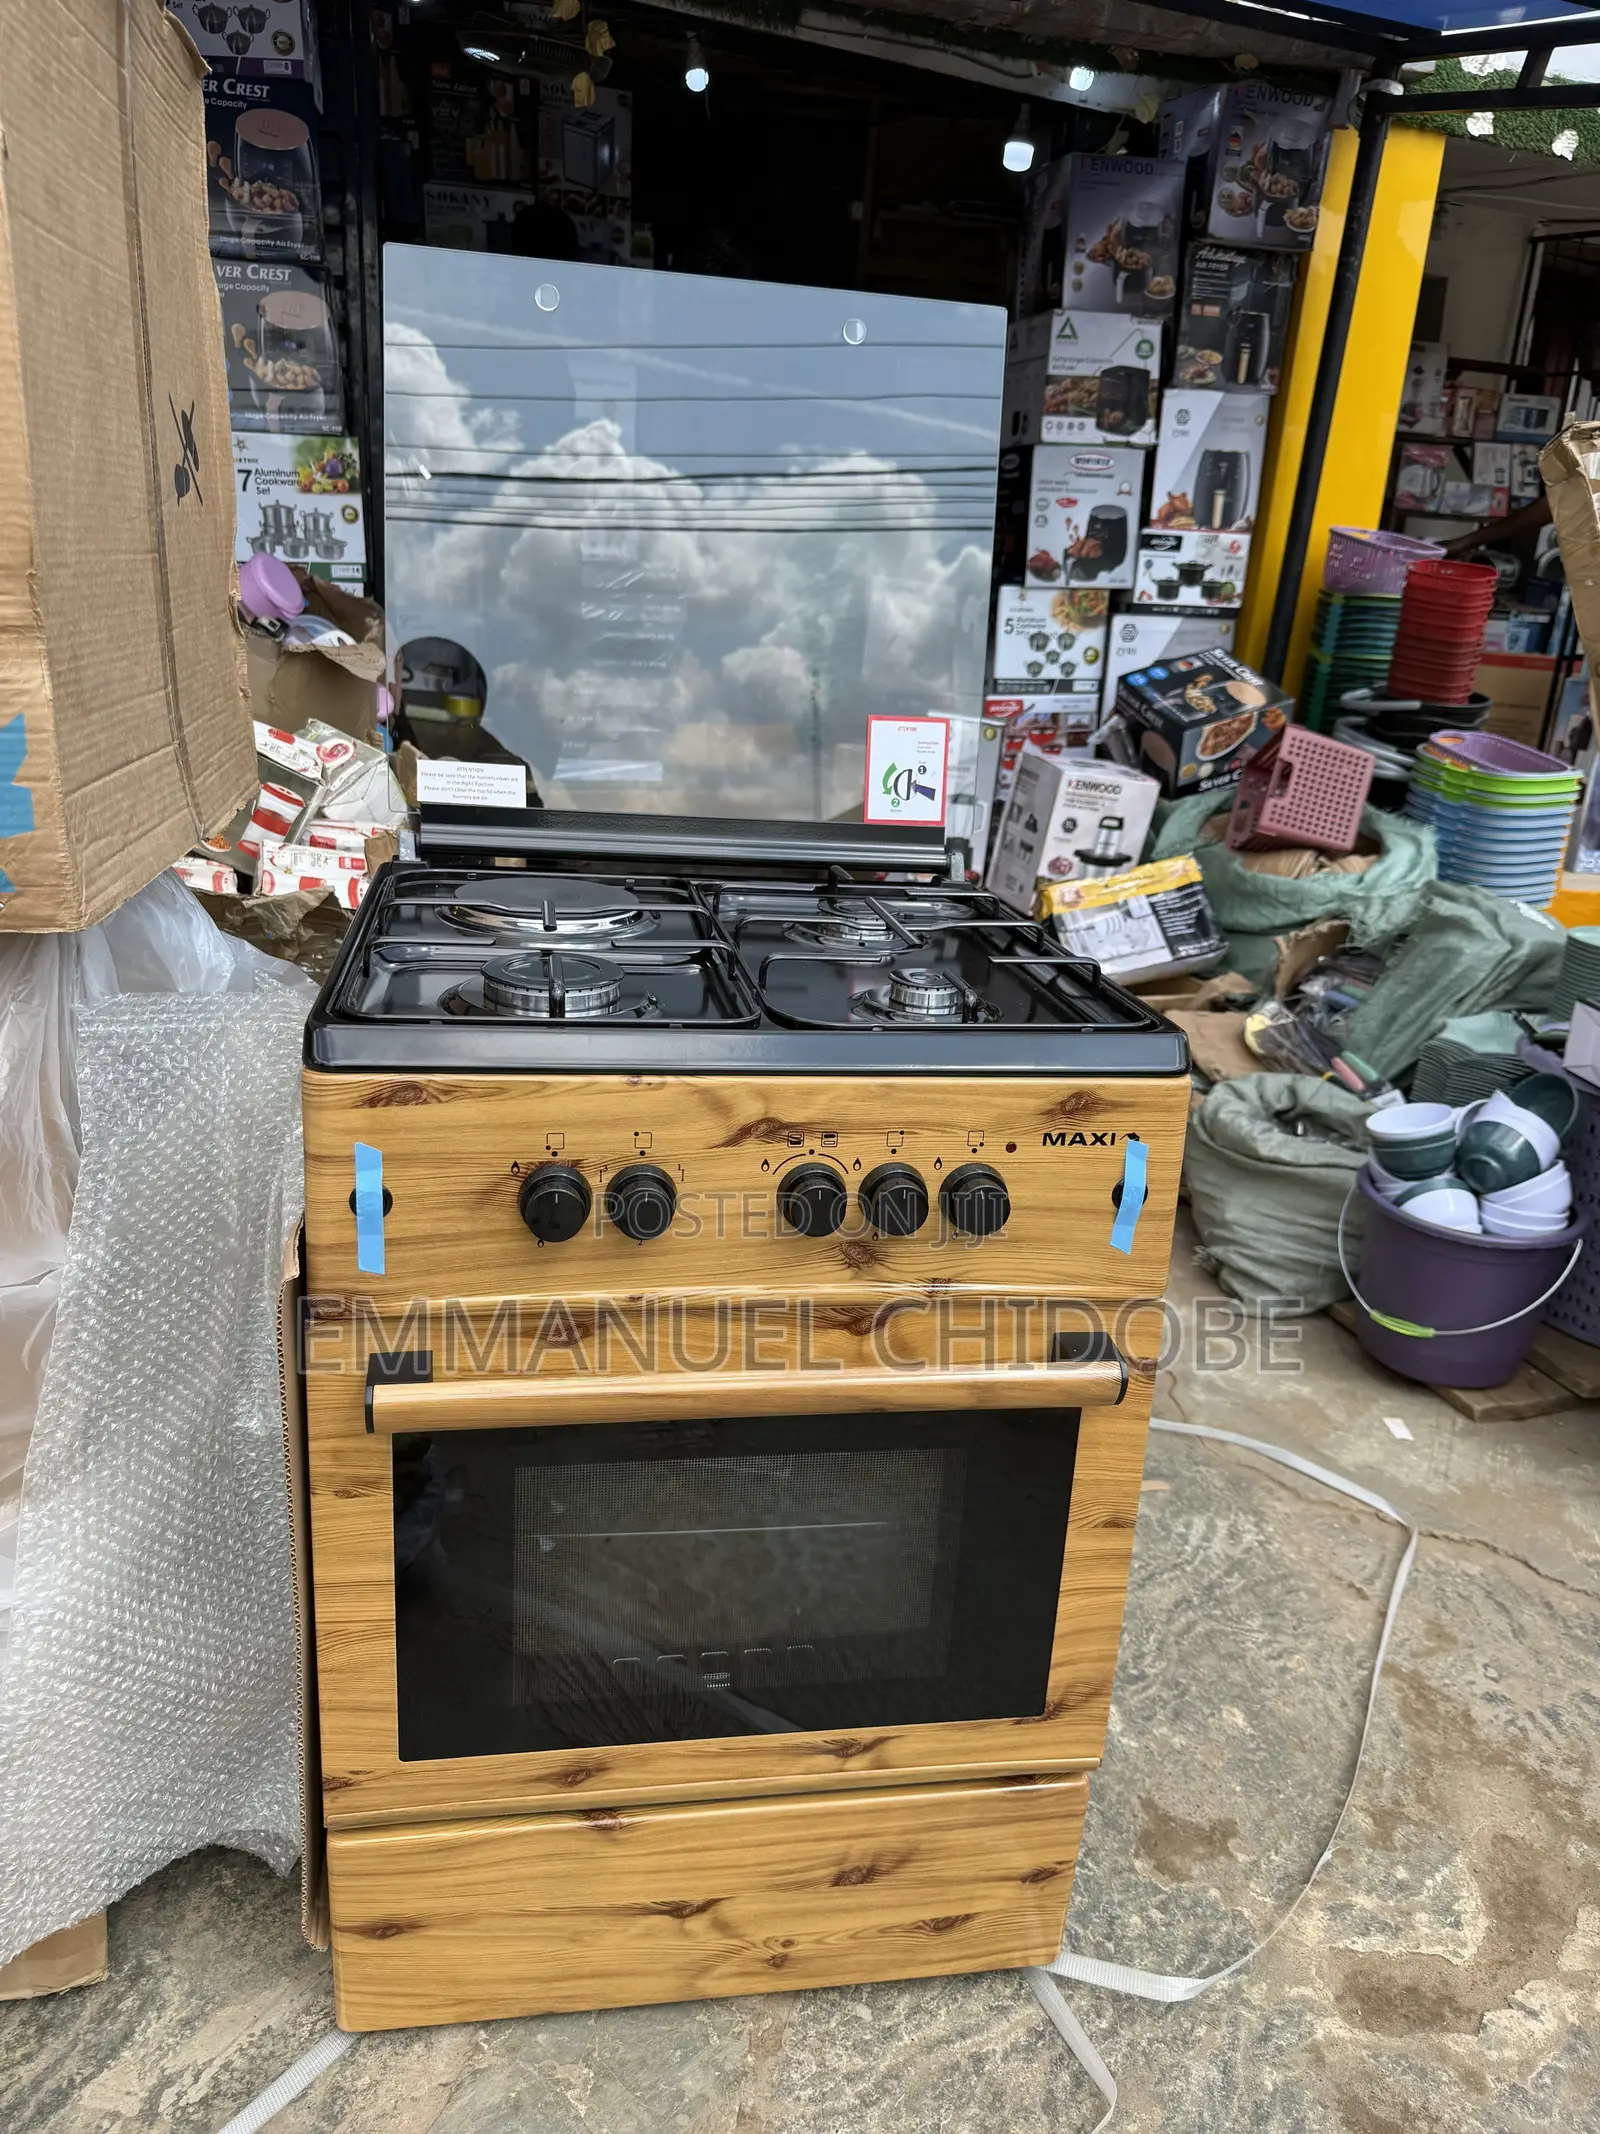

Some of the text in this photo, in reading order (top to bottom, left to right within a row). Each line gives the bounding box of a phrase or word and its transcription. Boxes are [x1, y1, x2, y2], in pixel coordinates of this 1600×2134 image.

[223, 78, 271, 98] CREST
[210, 97, 248, 109] Capacity
[240, 237, 275, 248] Capacity
[216, 264, 292, 281] VER CREST
[216, 282, 234, 291] arge
[235, 282, 270, 293] Capacity
[237, 468, 300, 492] 7 Aluminum
[255, 476, 302, 487] Cookware
[256, 486, 271, 495] Set
[1004, 617, 1014, 635] 5
[1068, 779, 1122, 795] KENWOOD
[1042, 1132, 1116, 1146] MAXI
